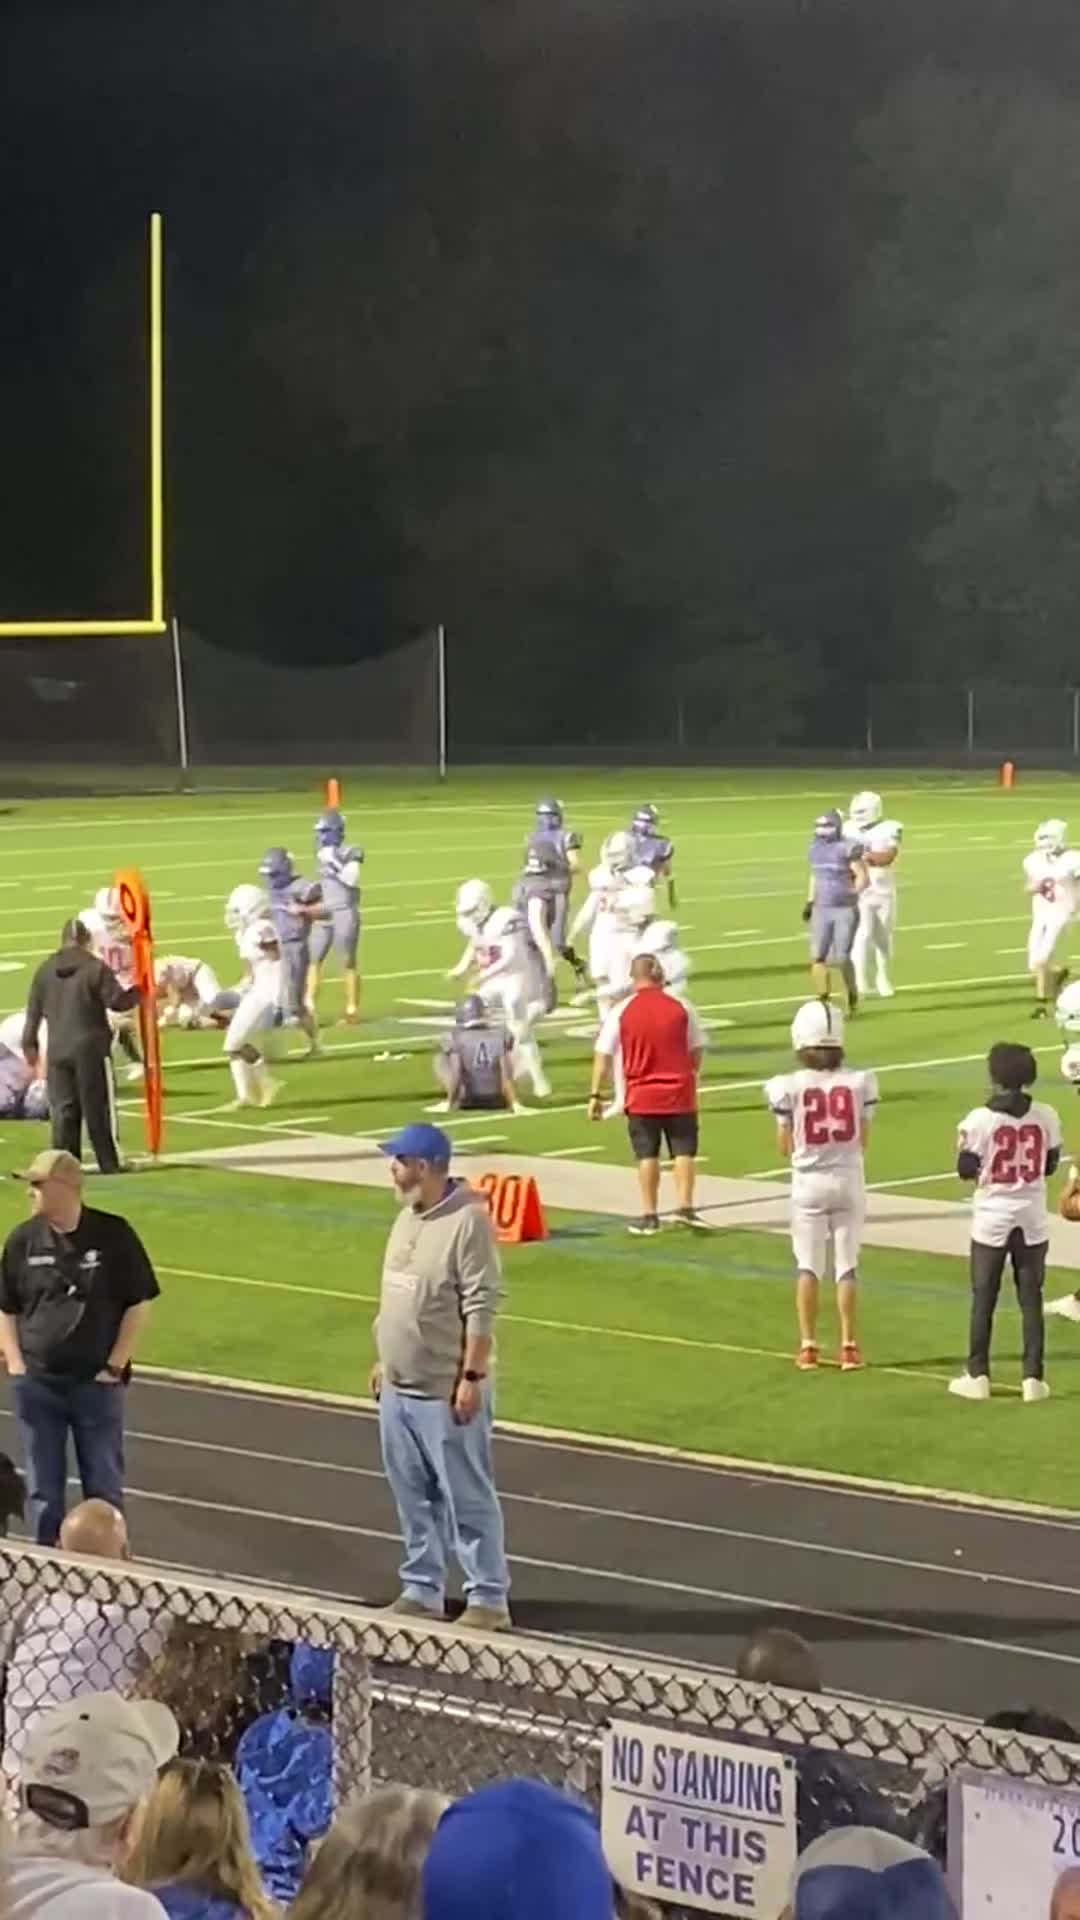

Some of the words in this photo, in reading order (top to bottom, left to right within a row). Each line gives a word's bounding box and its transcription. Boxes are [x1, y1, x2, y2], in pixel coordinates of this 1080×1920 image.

[803, 1086, 856, 1145] 29
[991, 1124, 1043, 1184] 23
[612, 1734, 643, 1786] NO
[652, 1744, 783, 1815] STANDING
[625, 1805, 667, 1841] AT
[681, 1816, 767, 1864] THIS
[636, 1852, 756, 1907] FENCE
